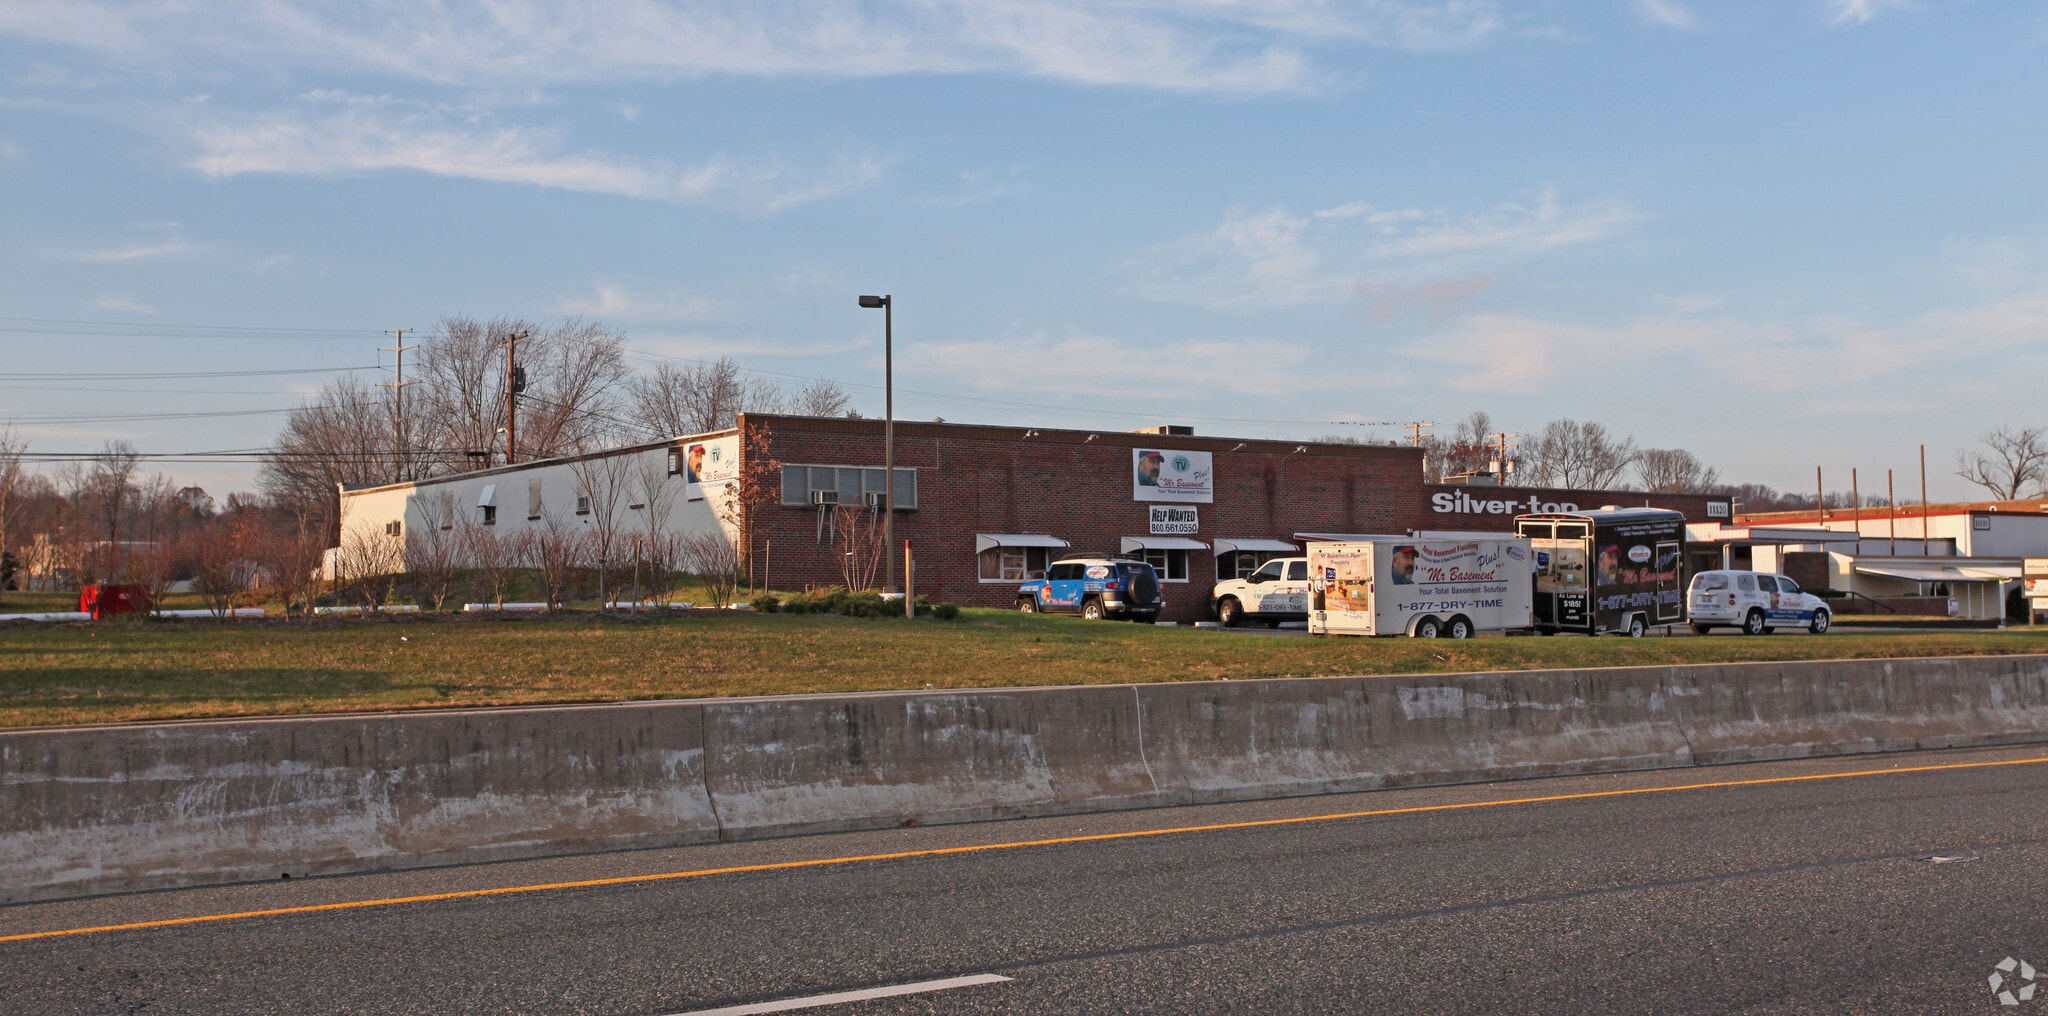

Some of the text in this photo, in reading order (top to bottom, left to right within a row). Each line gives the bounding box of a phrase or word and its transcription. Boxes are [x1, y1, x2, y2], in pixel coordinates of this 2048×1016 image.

[1175, 461, 1187, 471] TV
[1432, 489, 1579, 514] Silver-top
[1151, 523, 1197, 532] 800.661.0550
[1422, 543, 1479, 557] Total Basement Finishing
[1477, 545, 1500, 570] Plus!
[1418, 585, 1507, 595] Your Total Basement Solution
[1397, 599, 1504, 611] 1-877-DRY-TIME
[1598, 589, 1681, 610] 1-877-DRY-TIME
